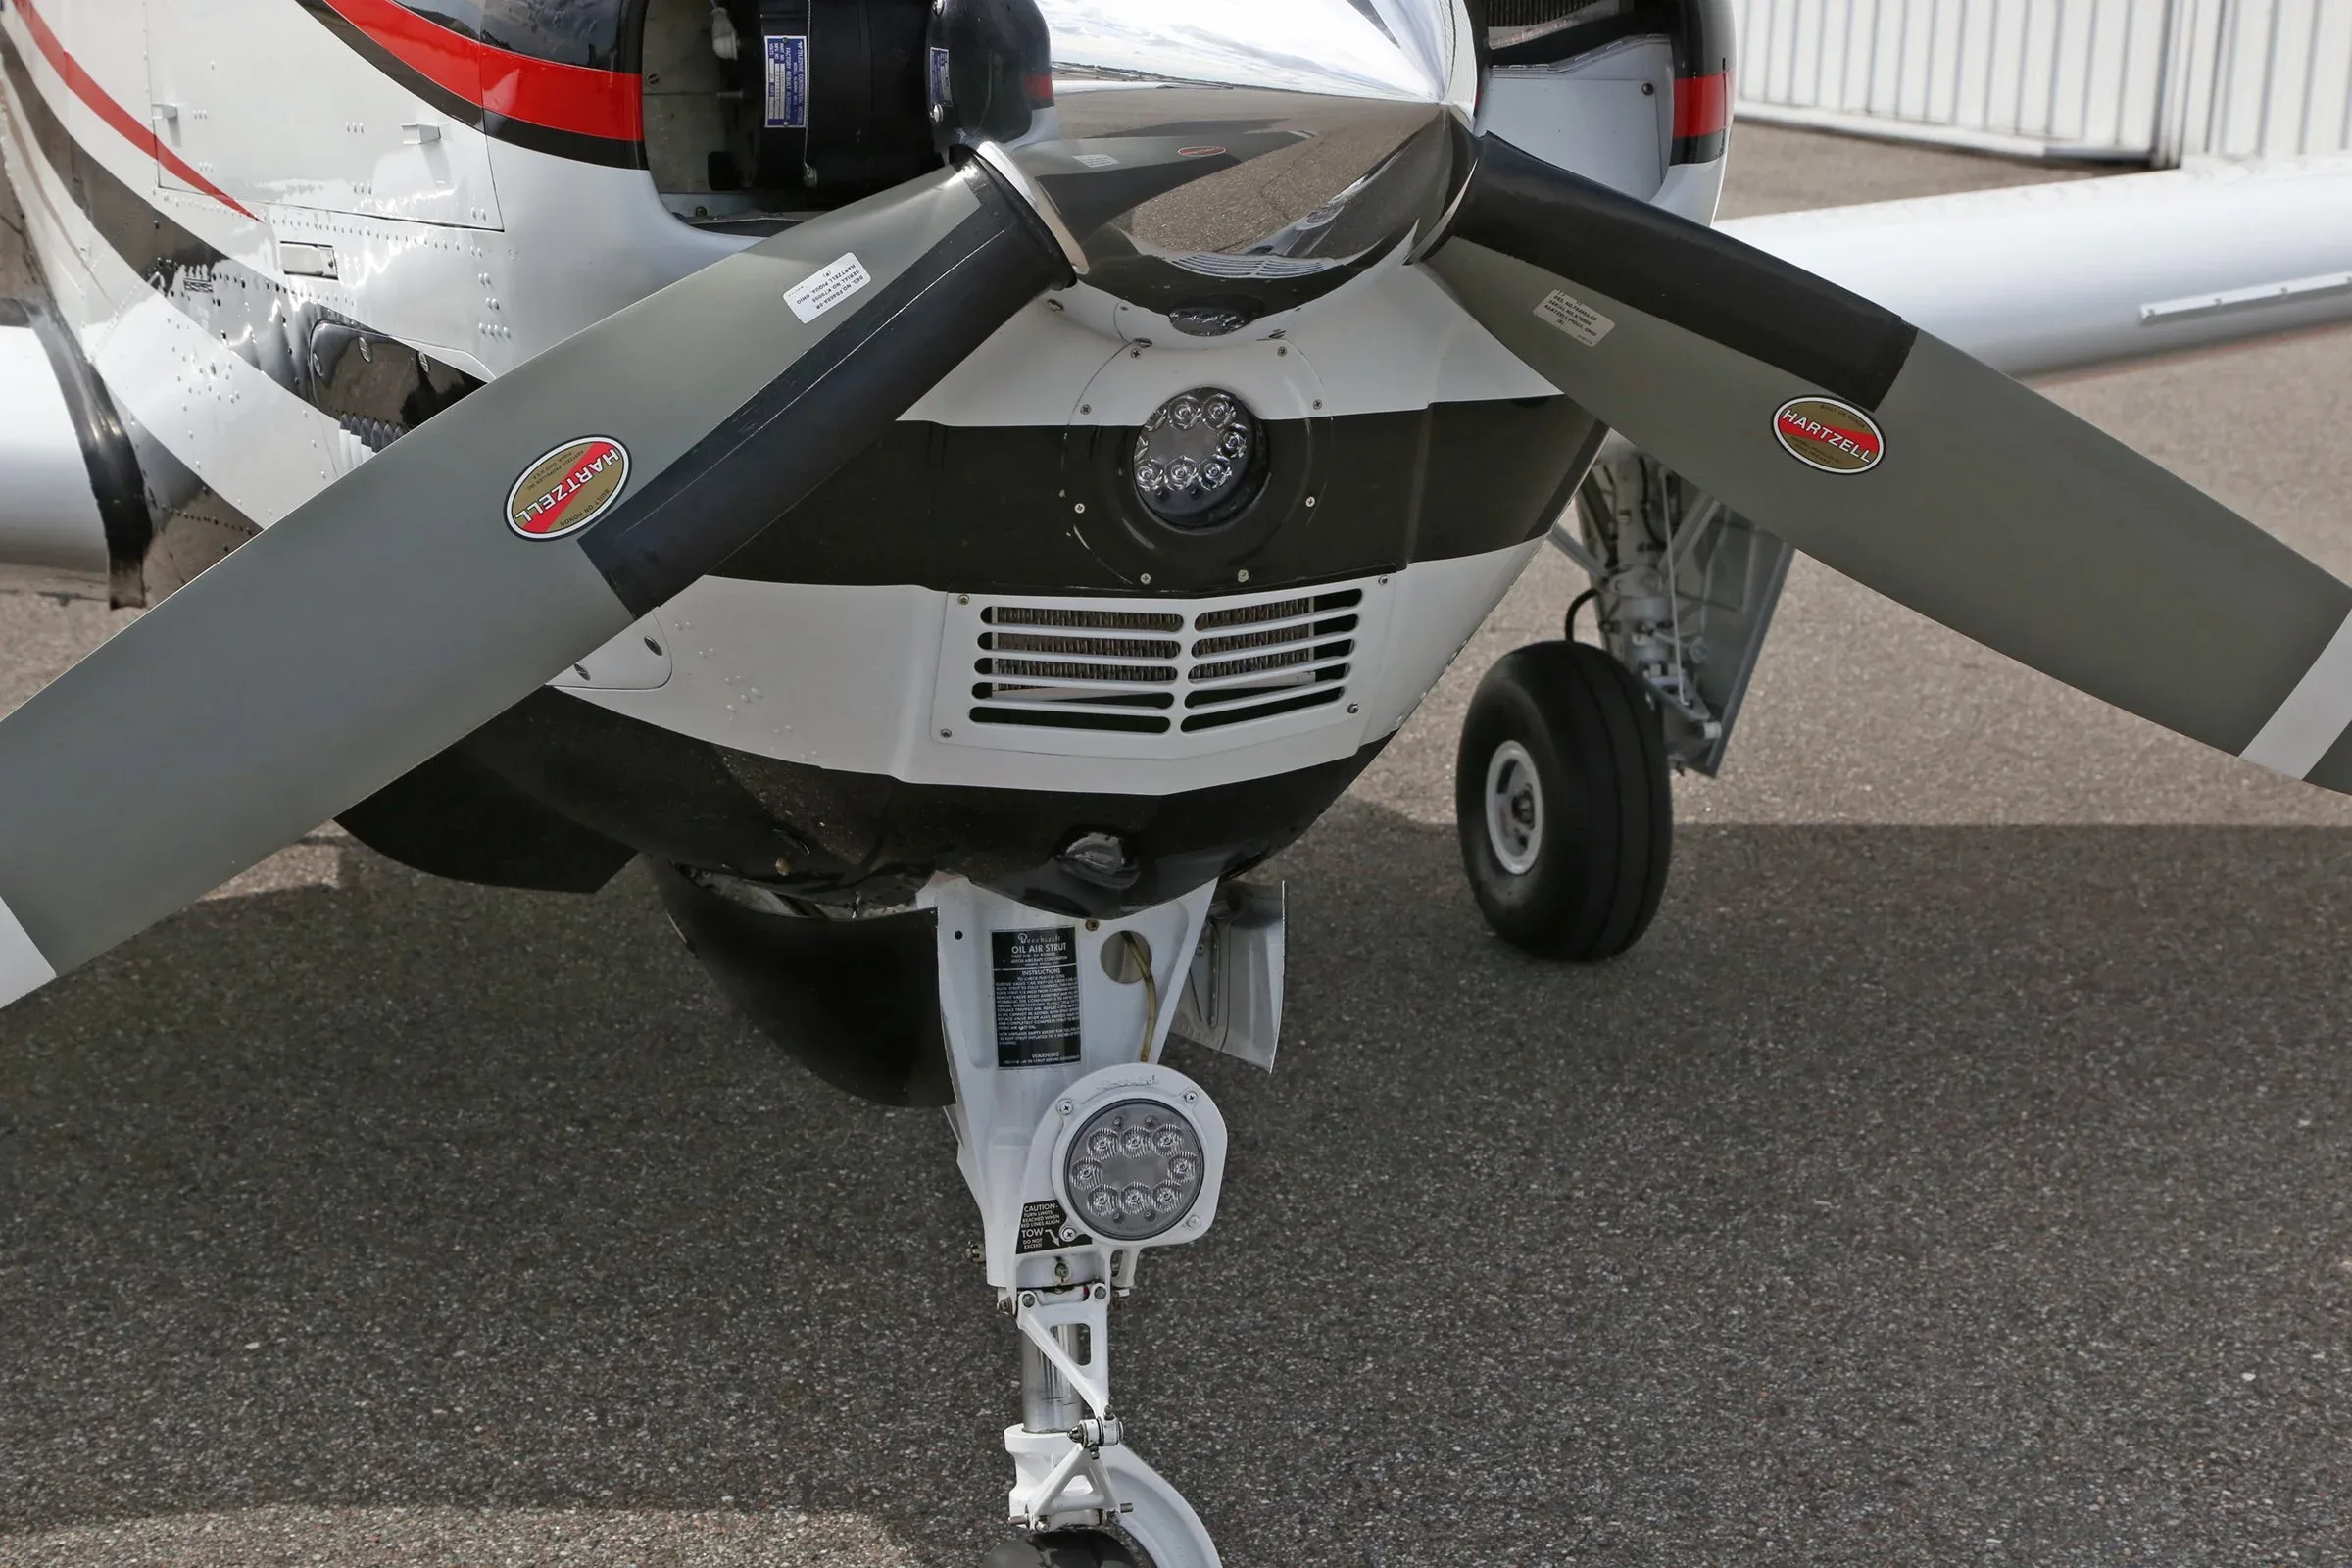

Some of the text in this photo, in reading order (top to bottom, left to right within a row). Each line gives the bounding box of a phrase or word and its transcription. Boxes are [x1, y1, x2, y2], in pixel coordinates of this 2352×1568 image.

[829, 264, 855, 282] HARTZELL
[842, 270, 860, 283] SERIAL
[797, 294, 810, 304] OHIO
[1782, 409, 1869, 463] HARTZELL
[515, 448, 619, 522] HARTZELL
[560, 488, 610, 526] BUILT ON HONOR
[1018, 933, 1060, 943] Beechcraft
[1045, 942, 1066, 951] STRUT
[1021, 1228, 1043, 1237] TOW
